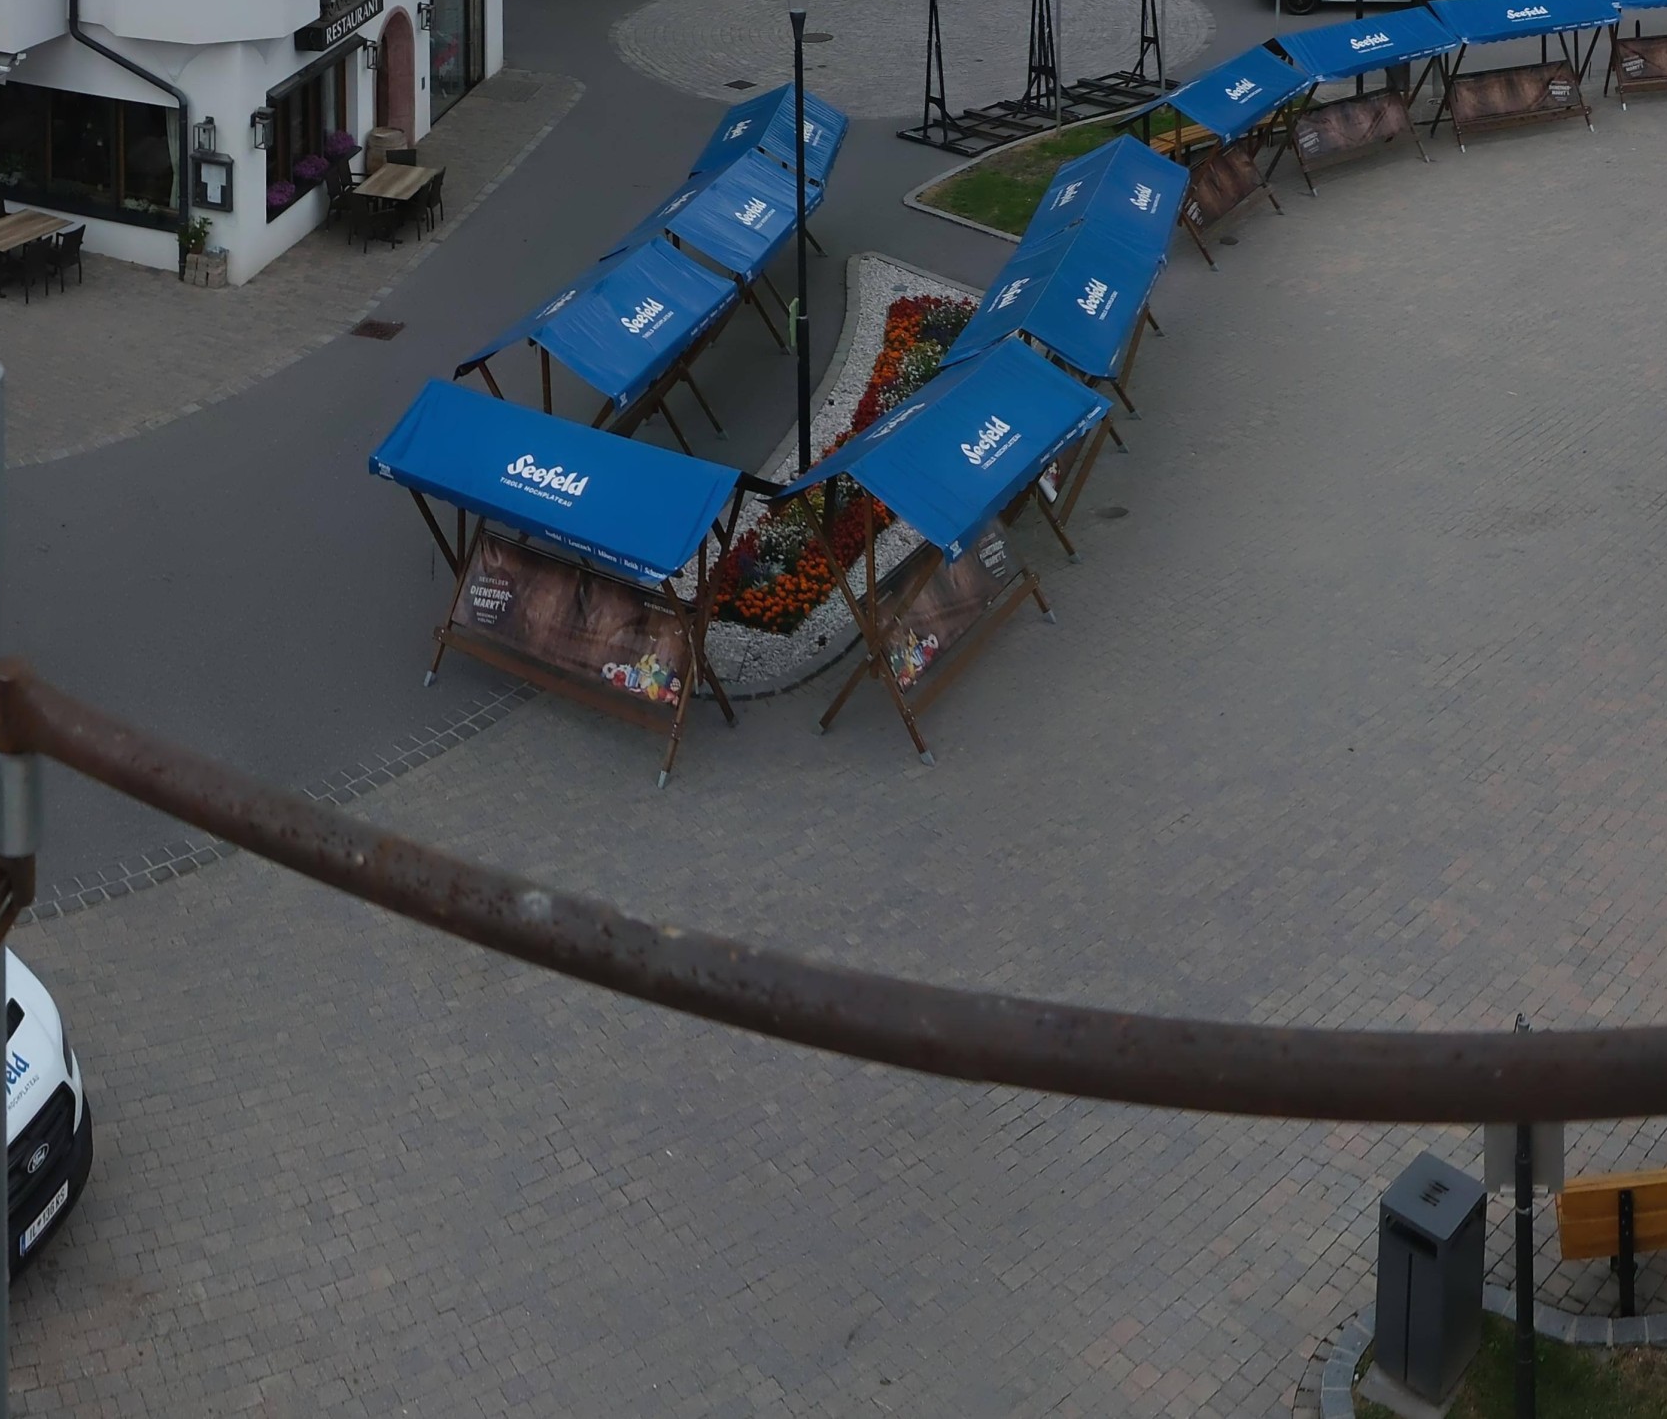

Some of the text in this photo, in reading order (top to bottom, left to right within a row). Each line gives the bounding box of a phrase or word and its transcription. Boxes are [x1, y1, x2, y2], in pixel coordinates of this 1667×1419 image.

[1507, 6, 1549, 21] Seefeld
[1350, 32, 1390, 50] Seefeld
[620, 297, 664, 334] Seefeld
[962, 415, 1010, 466] Seefeld
[507, 453, 589, 496] Seefeld
[500, 476, 573, 507] TIROLS HOCHPLATEAU
[479, 576, 509, 586] SEEFELDER
[470, 585, 513, 601] DIENSTAGS-
[473, 598, 508, 612] MARKT'L
